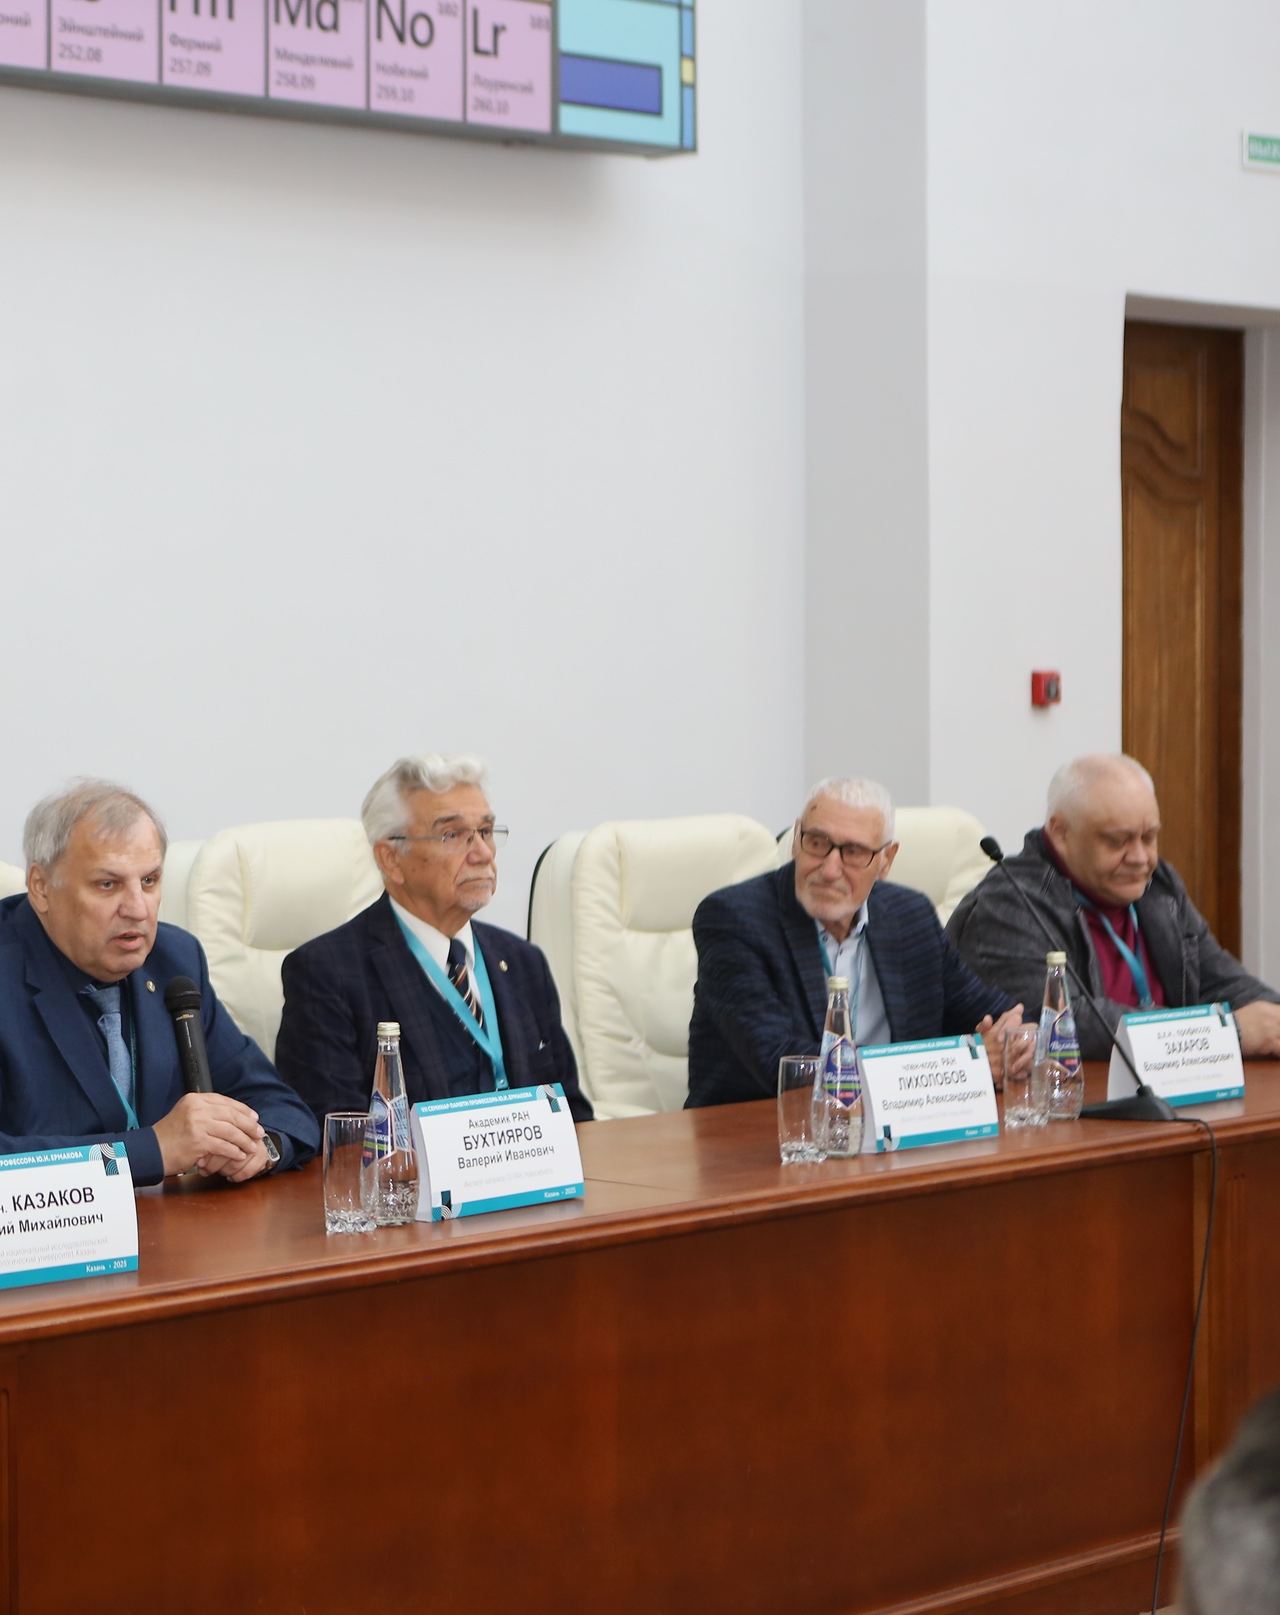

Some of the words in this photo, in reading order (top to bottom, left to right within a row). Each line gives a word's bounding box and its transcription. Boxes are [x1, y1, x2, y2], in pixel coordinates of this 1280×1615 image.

[376, 0, 435, 47] No
[473, 7, 507, 57] Lr
[899, 1070, 967, 1091] ЛИХОЛОБОВ
[882, 1096, 924, 1111] Владимир
[926, 1089, 987, 1105] Александрович
[468, 1115, 511, 1129] Академик
[512, 1110, 530, 1122] РАН
[463, 1125, 543, 1151] БУХТИЯРОВ
[36, 1155, 51, 1164] Ю.И.
[50, 1150, 84, 1162] ЕРМАКОВА
[457, 1151, 503, 1169] Валерий
[505, 1145, 555, 1161] Иванович
[11, 1186, 96, 1212] КАЗАКОВ
[19, 1212, 104, 1234] Михайлович
[86, 1263, 106, 1273] Казань
[113, 1260, 128, 1269] 2025
